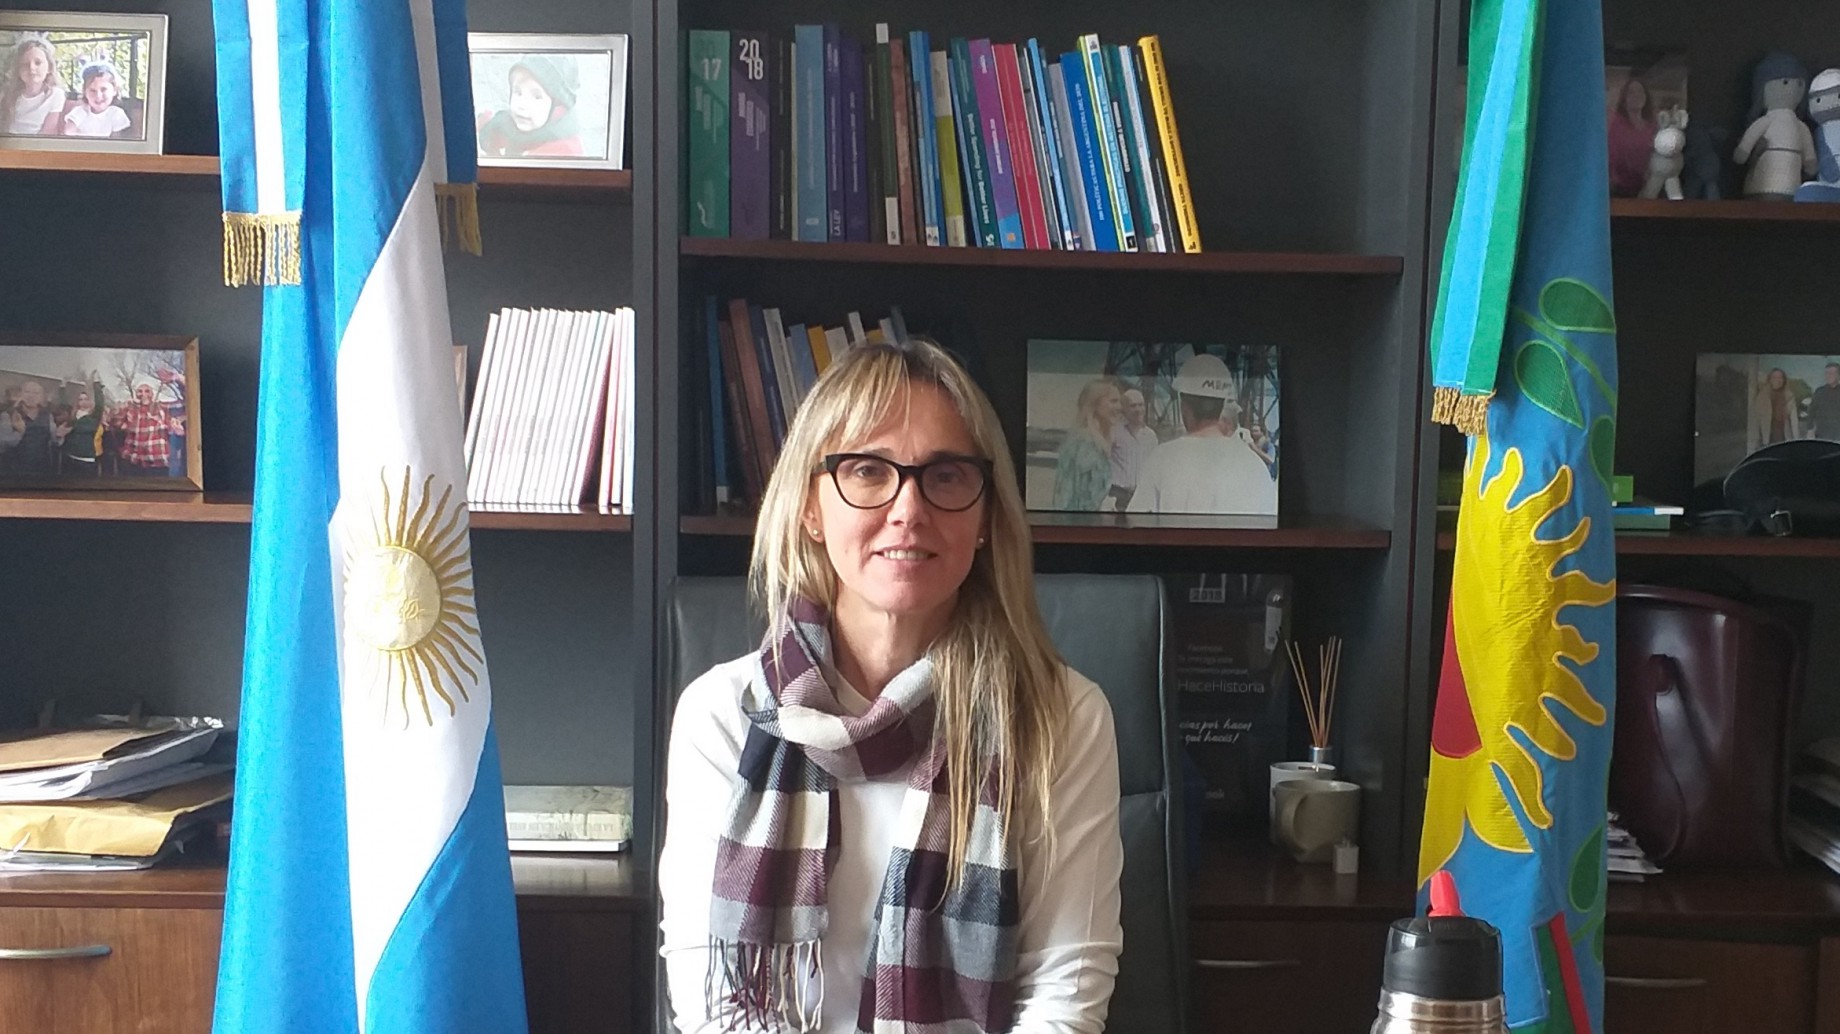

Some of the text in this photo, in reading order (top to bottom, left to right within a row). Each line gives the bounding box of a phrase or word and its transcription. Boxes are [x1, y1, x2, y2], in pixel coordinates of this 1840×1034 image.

[739, 39, 759, 61] 20
[702, 58, 721, 80] 17
[746, 58, 763, 80] 18
